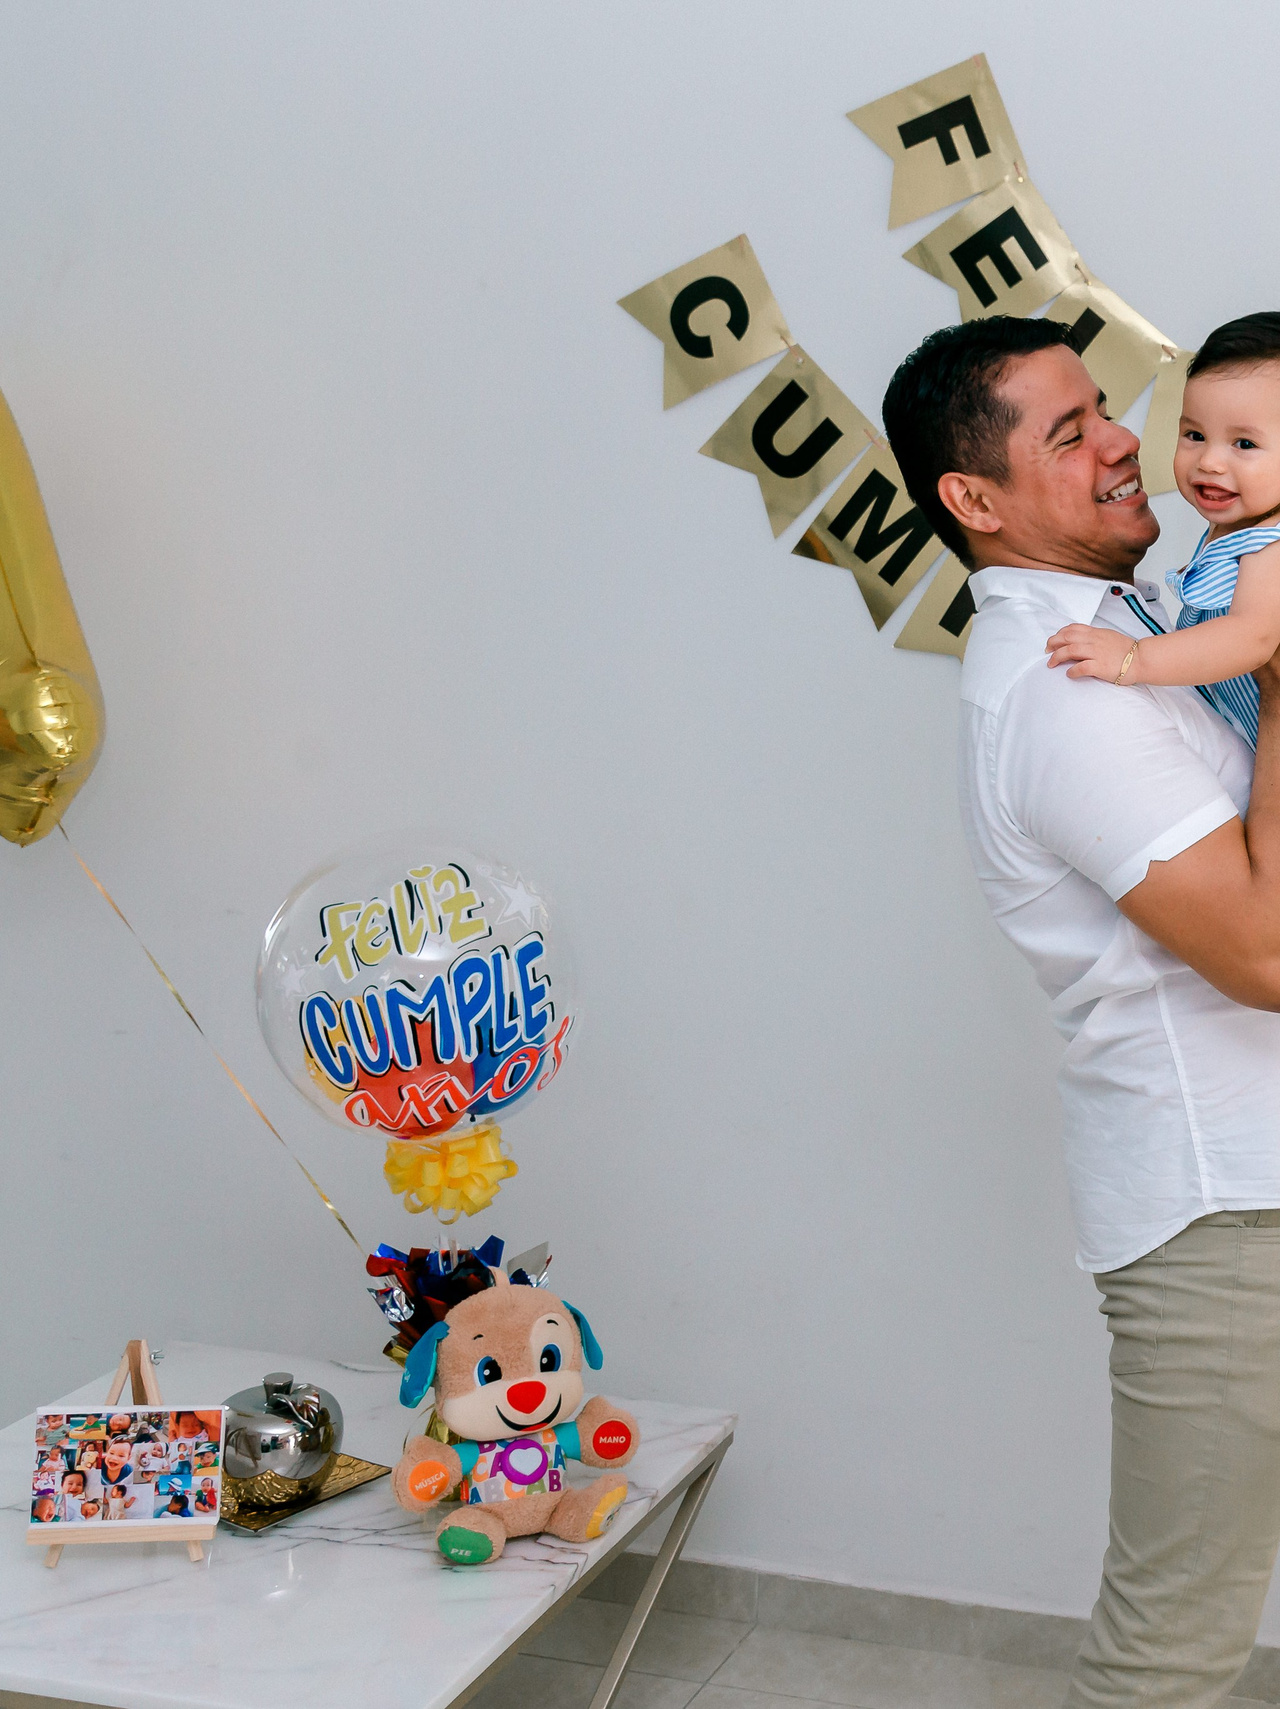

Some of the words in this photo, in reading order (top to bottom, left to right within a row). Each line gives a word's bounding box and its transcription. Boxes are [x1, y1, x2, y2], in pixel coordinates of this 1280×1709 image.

[300, 931, 555, 1092] CUMPLE
[599, 1435, 626, 1444] MANO
[450, 1548, 472, 1556] PIE
